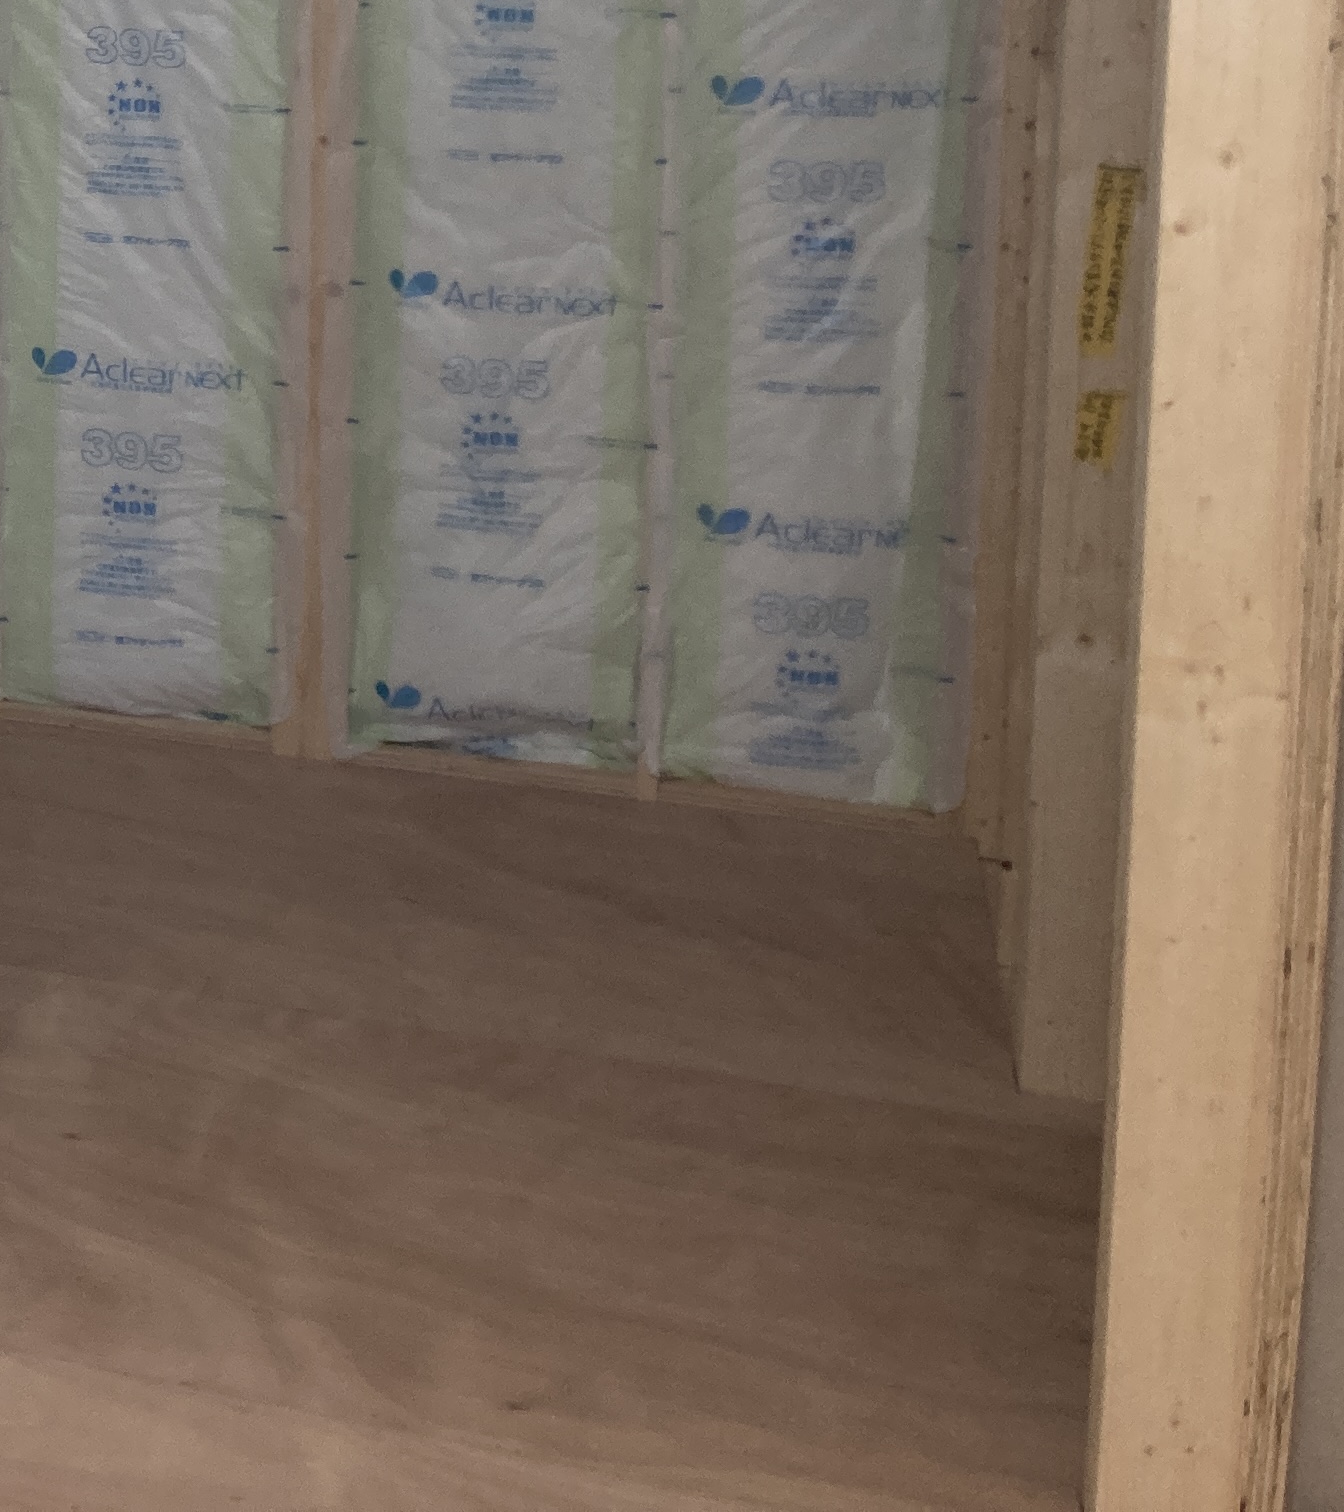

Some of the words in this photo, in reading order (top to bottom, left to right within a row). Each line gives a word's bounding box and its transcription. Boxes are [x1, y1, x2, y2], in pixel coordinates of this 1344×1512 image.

[85, 26, 187, 69] 395
[118, 97, 161, 115] NON
[440, 357, 551, 399] 395
[80, 428, 184, 474] 395
[113, 499, 157, 516] NON
